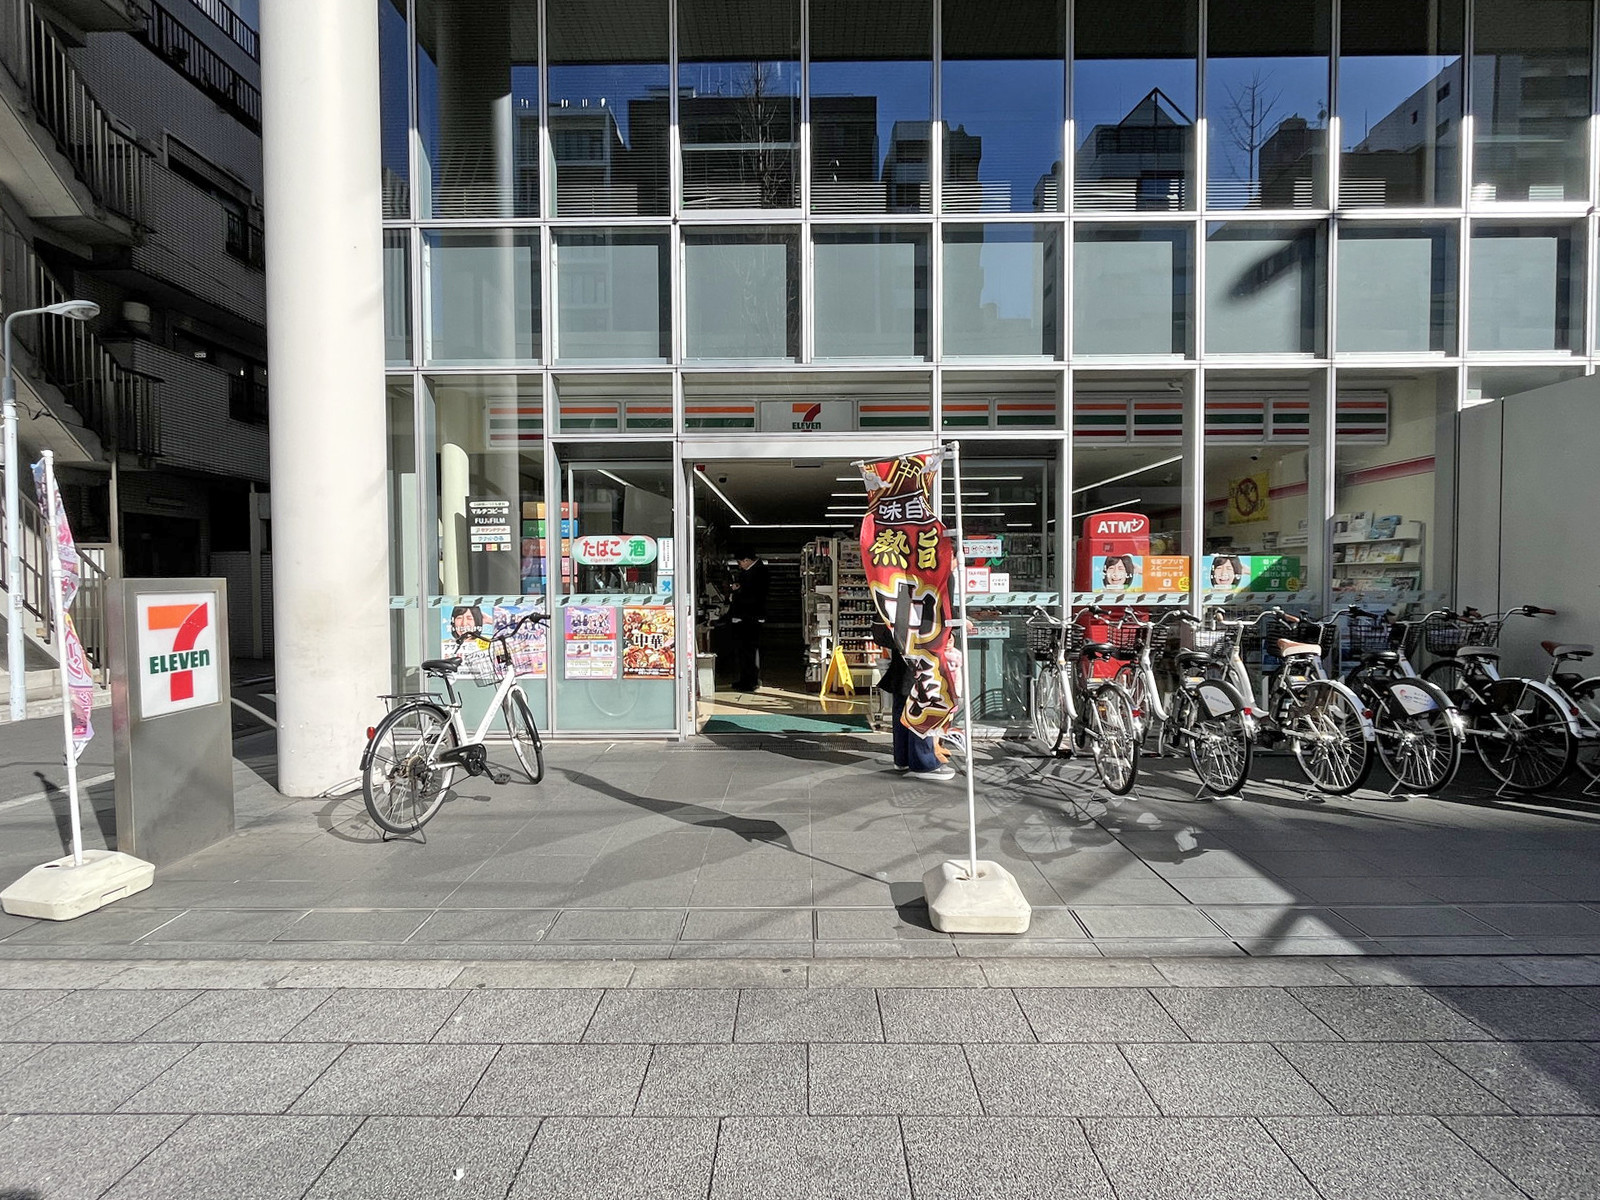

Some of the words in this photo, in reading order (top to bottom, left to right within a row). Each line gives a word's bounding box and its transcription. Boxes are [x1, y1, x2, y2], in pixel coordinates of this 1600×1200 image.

[1097, 521, 1131, 534] ATM
[582, 540, 622, 557] たばこ
[628, 539, 646, 557] 酒
[634, 633, 664, 649] 中華
[147, 601, 208, 702] 7
